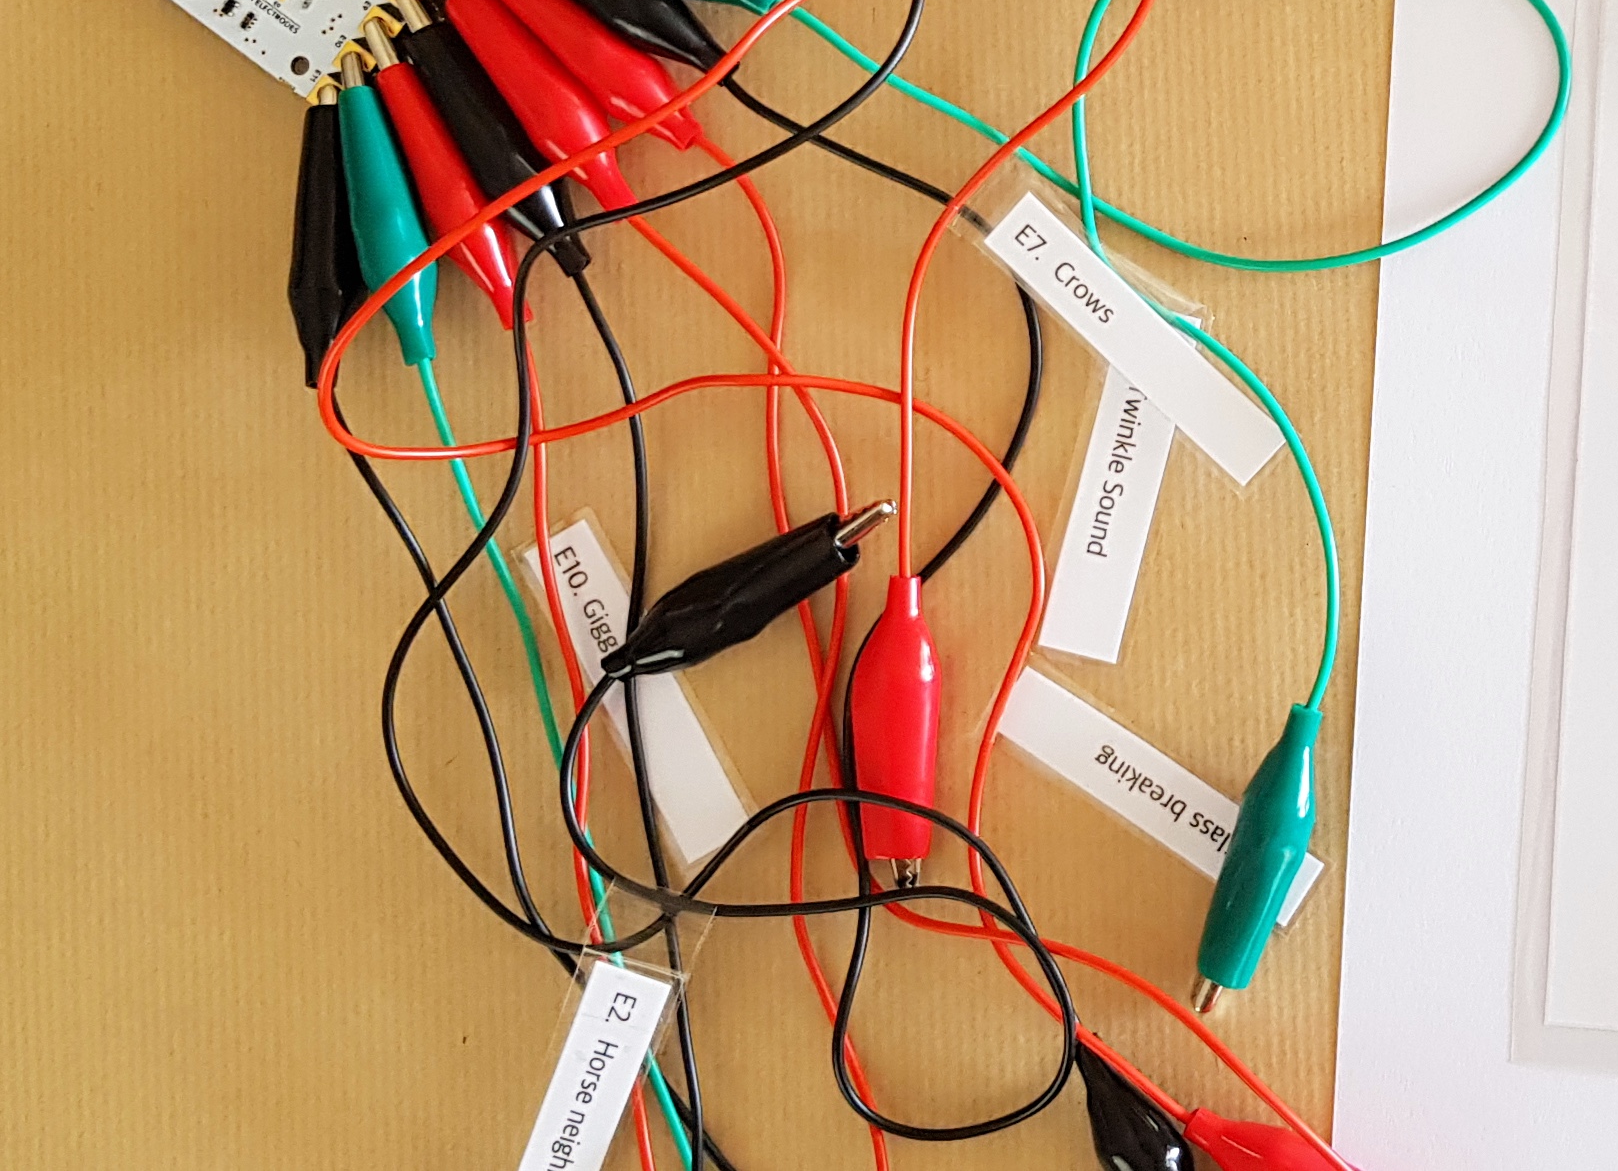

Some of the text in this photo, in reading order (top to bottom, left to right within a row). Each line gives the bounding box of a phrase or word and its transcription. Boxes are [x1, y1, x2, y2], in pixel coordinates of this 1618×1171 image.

[1014, 223, 1115, 324] E7. Crows
[1086, 479, 1124, 558] Sound
[553, 545, 618, 653] E10. Gigg
[1094, 744, 1231, 853] lass breaking
[545, 992, 638, 1171] E2. Horse neigh
